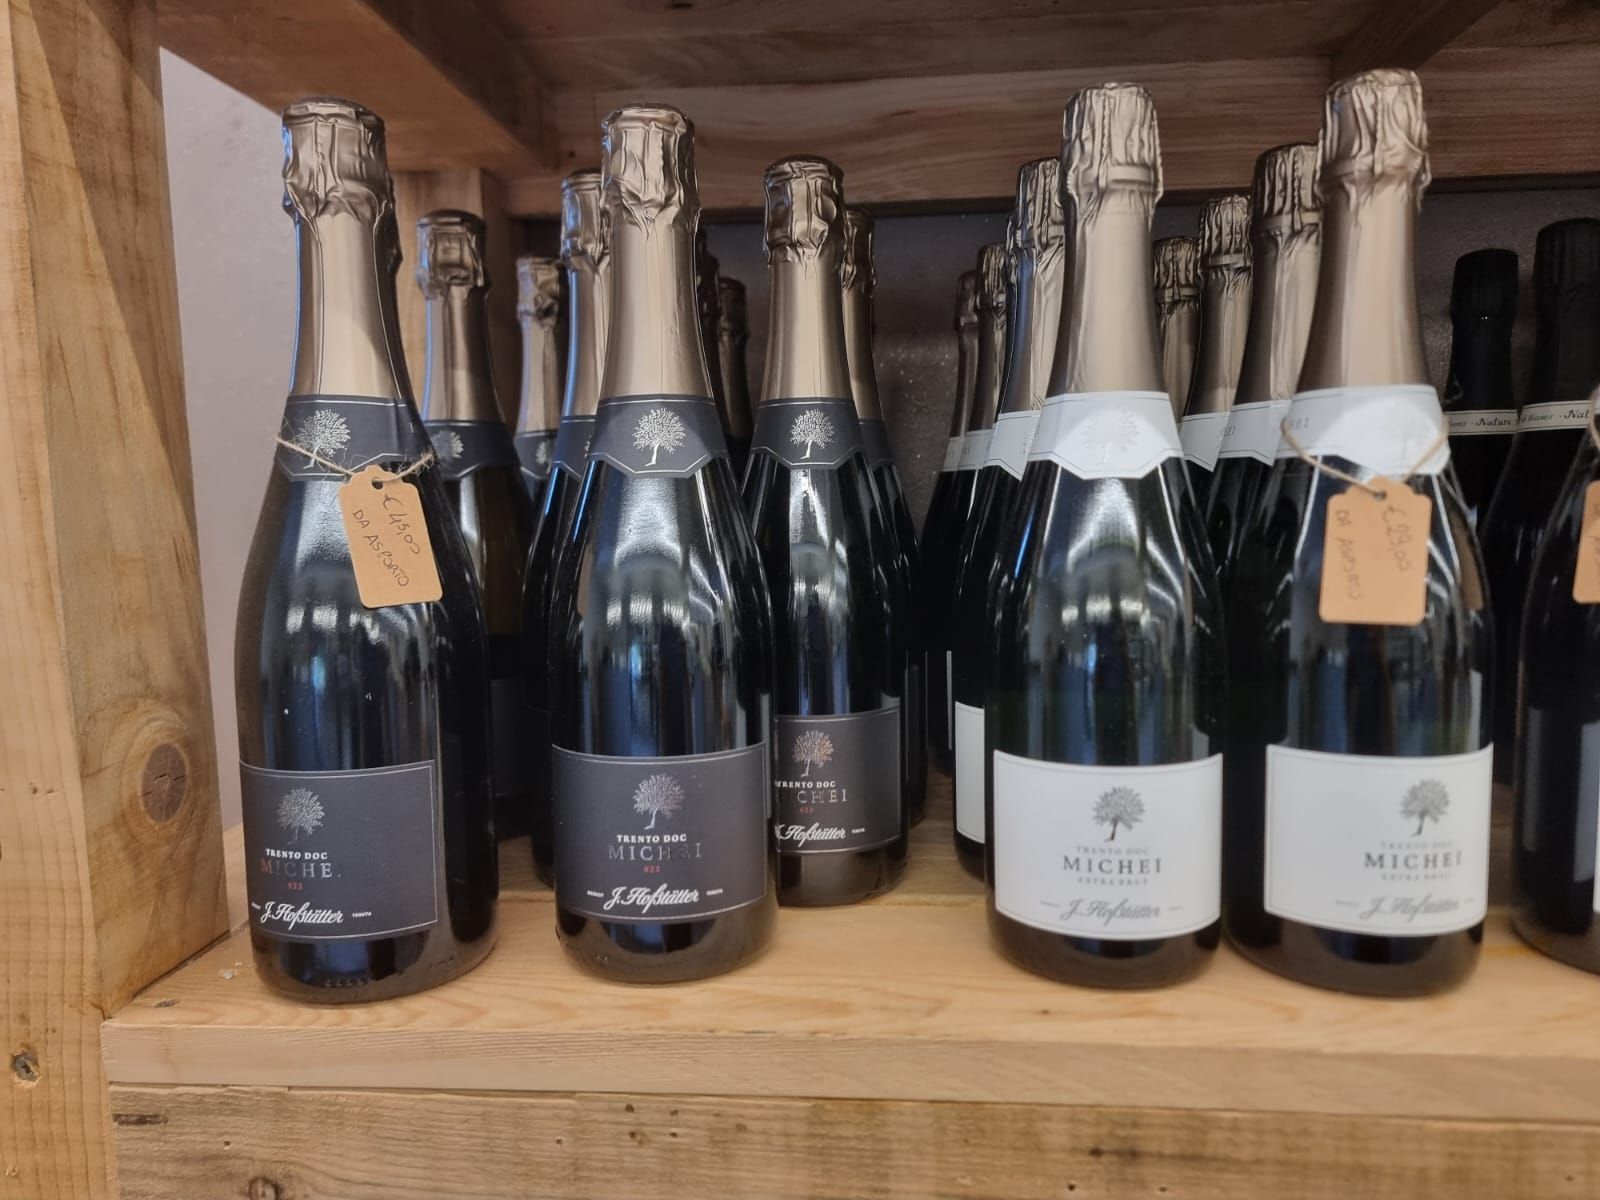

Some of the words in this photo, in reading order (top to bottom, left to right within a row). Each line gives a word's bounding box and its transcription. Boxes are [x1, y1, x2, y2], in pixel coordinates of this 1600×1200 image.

[352, 509, 370, 529] DA
[363, 534, 410, 587] ASPORTO
[774, 780, 814, 789] TRENTO
[816, 780, 837, 788] DOC
[617, 834, 660, 844] TRENTO
[663, 833, 688, 843] DOC
[265, 848, 301, 860] TRENTO
[304, 852, 328, 860] DOC
[608, 842, 702, 861] MICHI
[1364, 850, 1462, 870] MICHEI
[260, 858, 342, 879] MICHE
[1062, 855, 1162, 875] MICHEI
